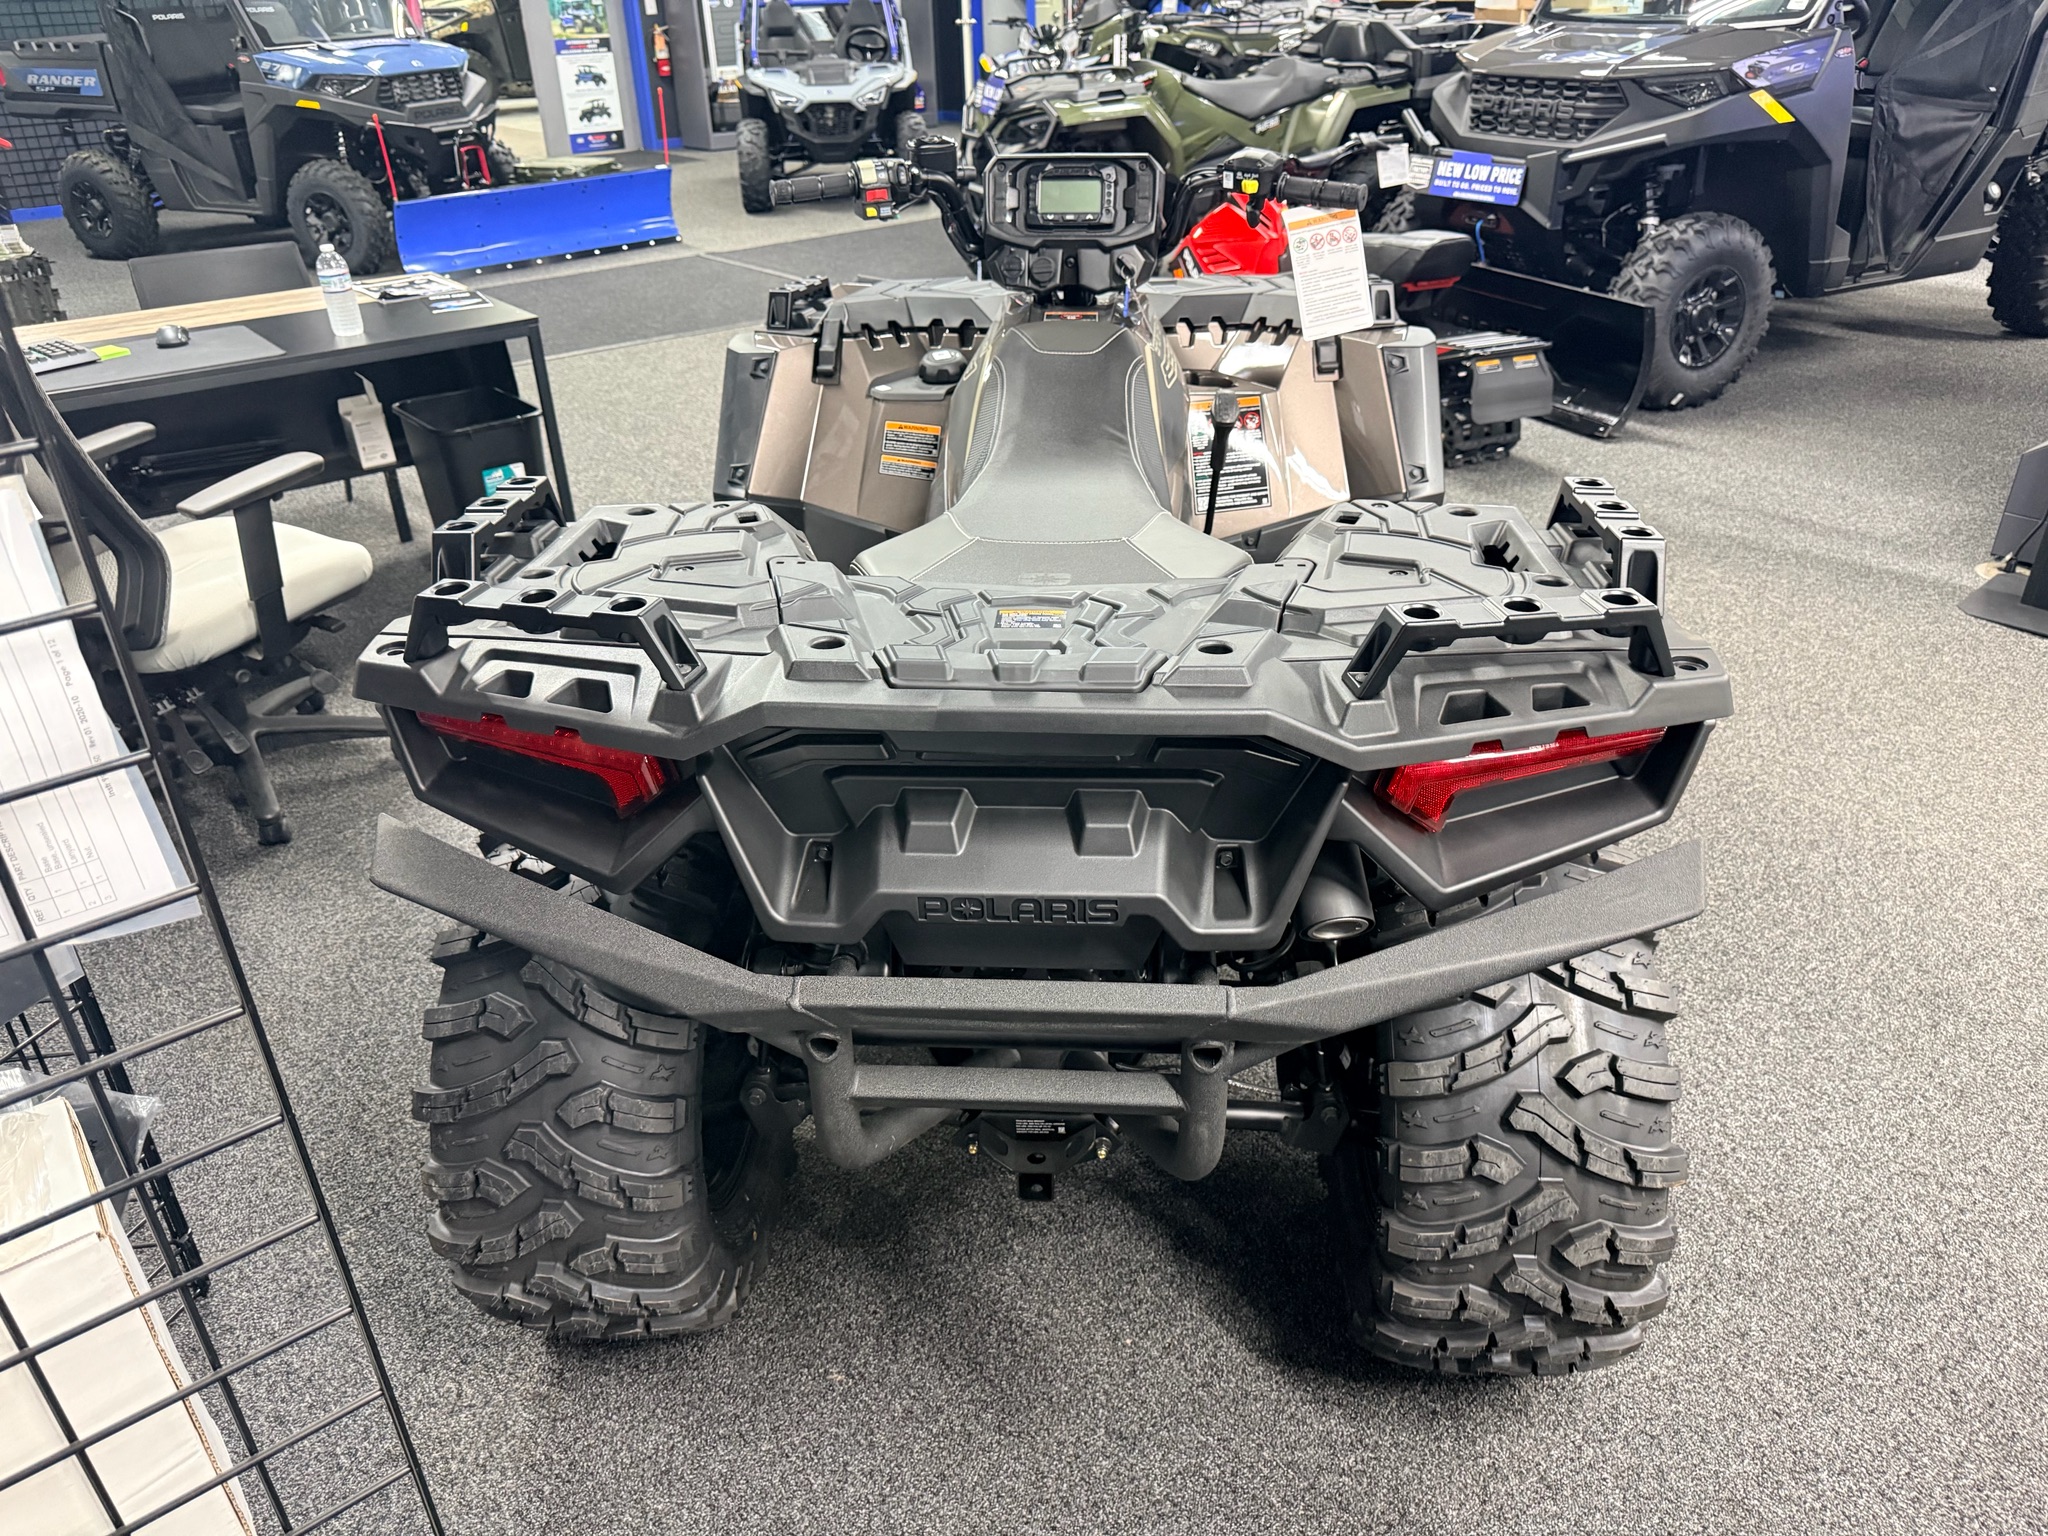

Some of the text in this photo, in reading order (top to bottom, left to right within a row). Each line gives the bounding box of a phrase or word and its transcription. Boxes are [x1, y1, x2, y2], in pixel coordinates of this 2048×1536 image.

[151, 13, 185, 21] POLARIS
[26, 74, 97, 87] RANGER
[1482, 95, 1575, 119] POLARIS
[1436, 160, 1465, 180] NEW
[1463, 164, 1491, 182] LOW
[1489, 166, 1524, 185] PRICE
[47, 638, 57, 648] 12
[52, 649, 61, 658] of
[61, 666, 73, 687] Page
[71, 695, 88, 724] 2020-10
[61, 838, 79, 865] Lanyard
[83, 846, 95, 859] Nut
[12, 862, 27, 881] PART
[41, 856, 53, 873] Base
[24, 887, 46, 922] REF QTY
[917, 897, 1119, 925] POLARIS
